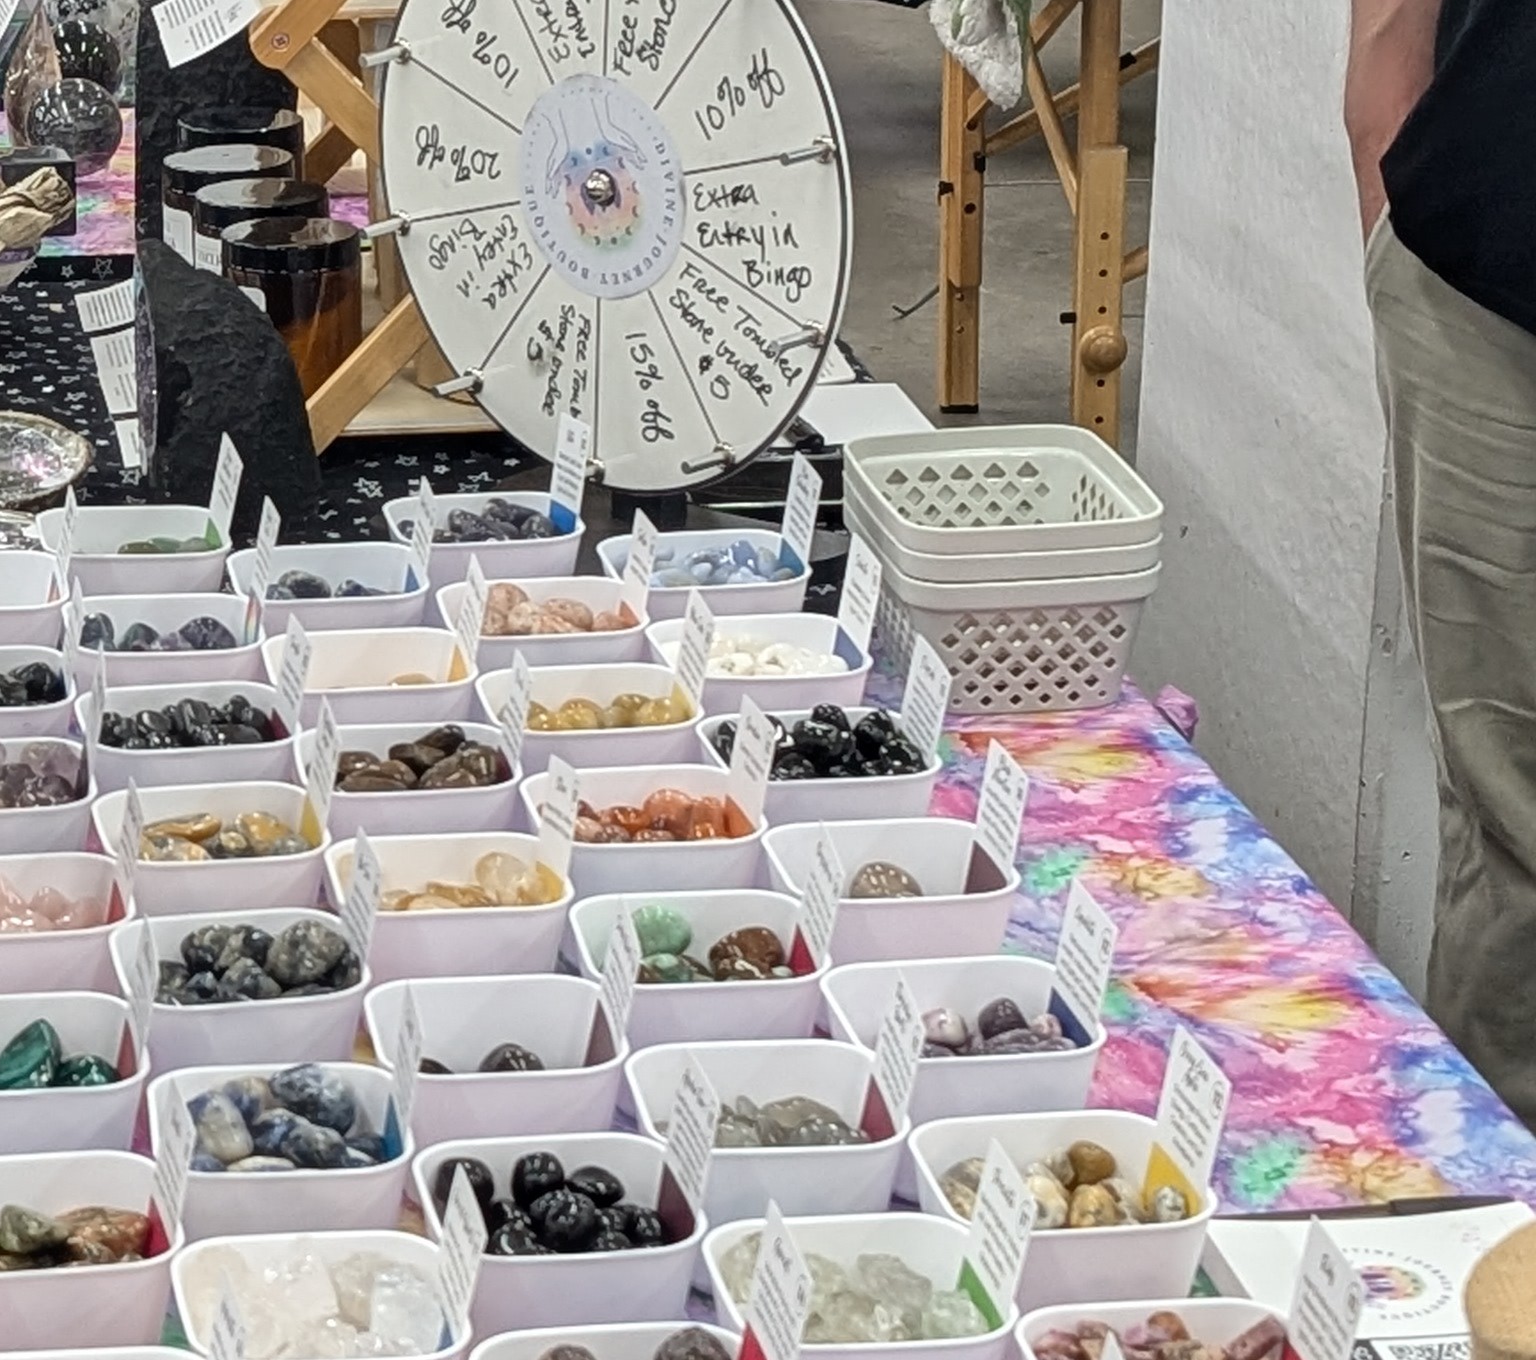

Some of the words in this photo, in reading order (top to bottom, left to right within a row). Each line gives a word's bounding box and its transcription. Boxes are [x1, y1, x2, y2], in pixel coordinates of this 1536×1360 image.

[471, 31, 520, 90] 10%
[695, 75, 746, 141] 10%
[747, 47, 785, 109] off
[415, 123, 446, 170] off
[450, 145, 502, 183] 20%
[653, 142, 677, 228] DIVINE
[524, 184, 591, 281] BOUTIQUE
[771, 211, 800, 250] in
[598, 233, 668, 286] JOURNEY
[742, 259, 813, 304] Bingo
[625, 332, 664, 391] 15%
[640, 398, 675, 443] off
